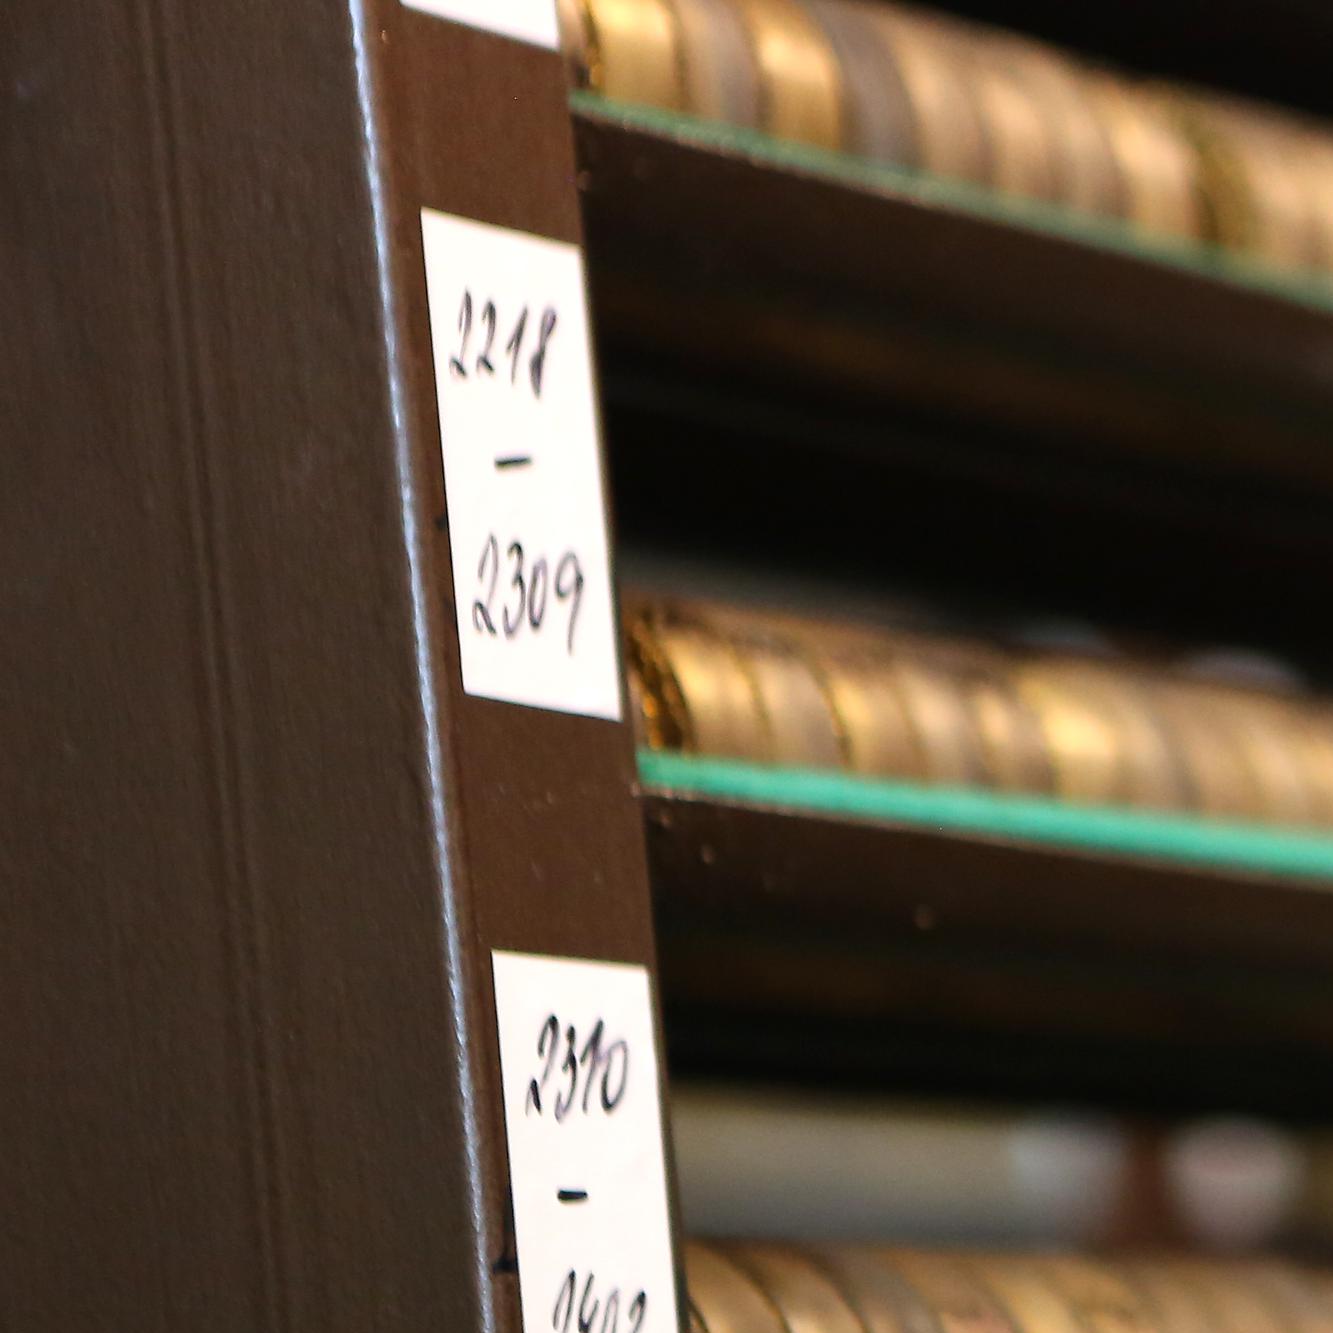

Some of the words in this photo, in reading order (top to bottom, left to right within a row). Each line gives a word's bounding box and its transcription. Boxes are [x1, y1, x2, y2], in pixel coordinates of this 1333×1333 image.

[449, 285, 558, 399] 2218
[472, 533, 584, 655] 2309
[526, 1013, 629, 1124] 2310
